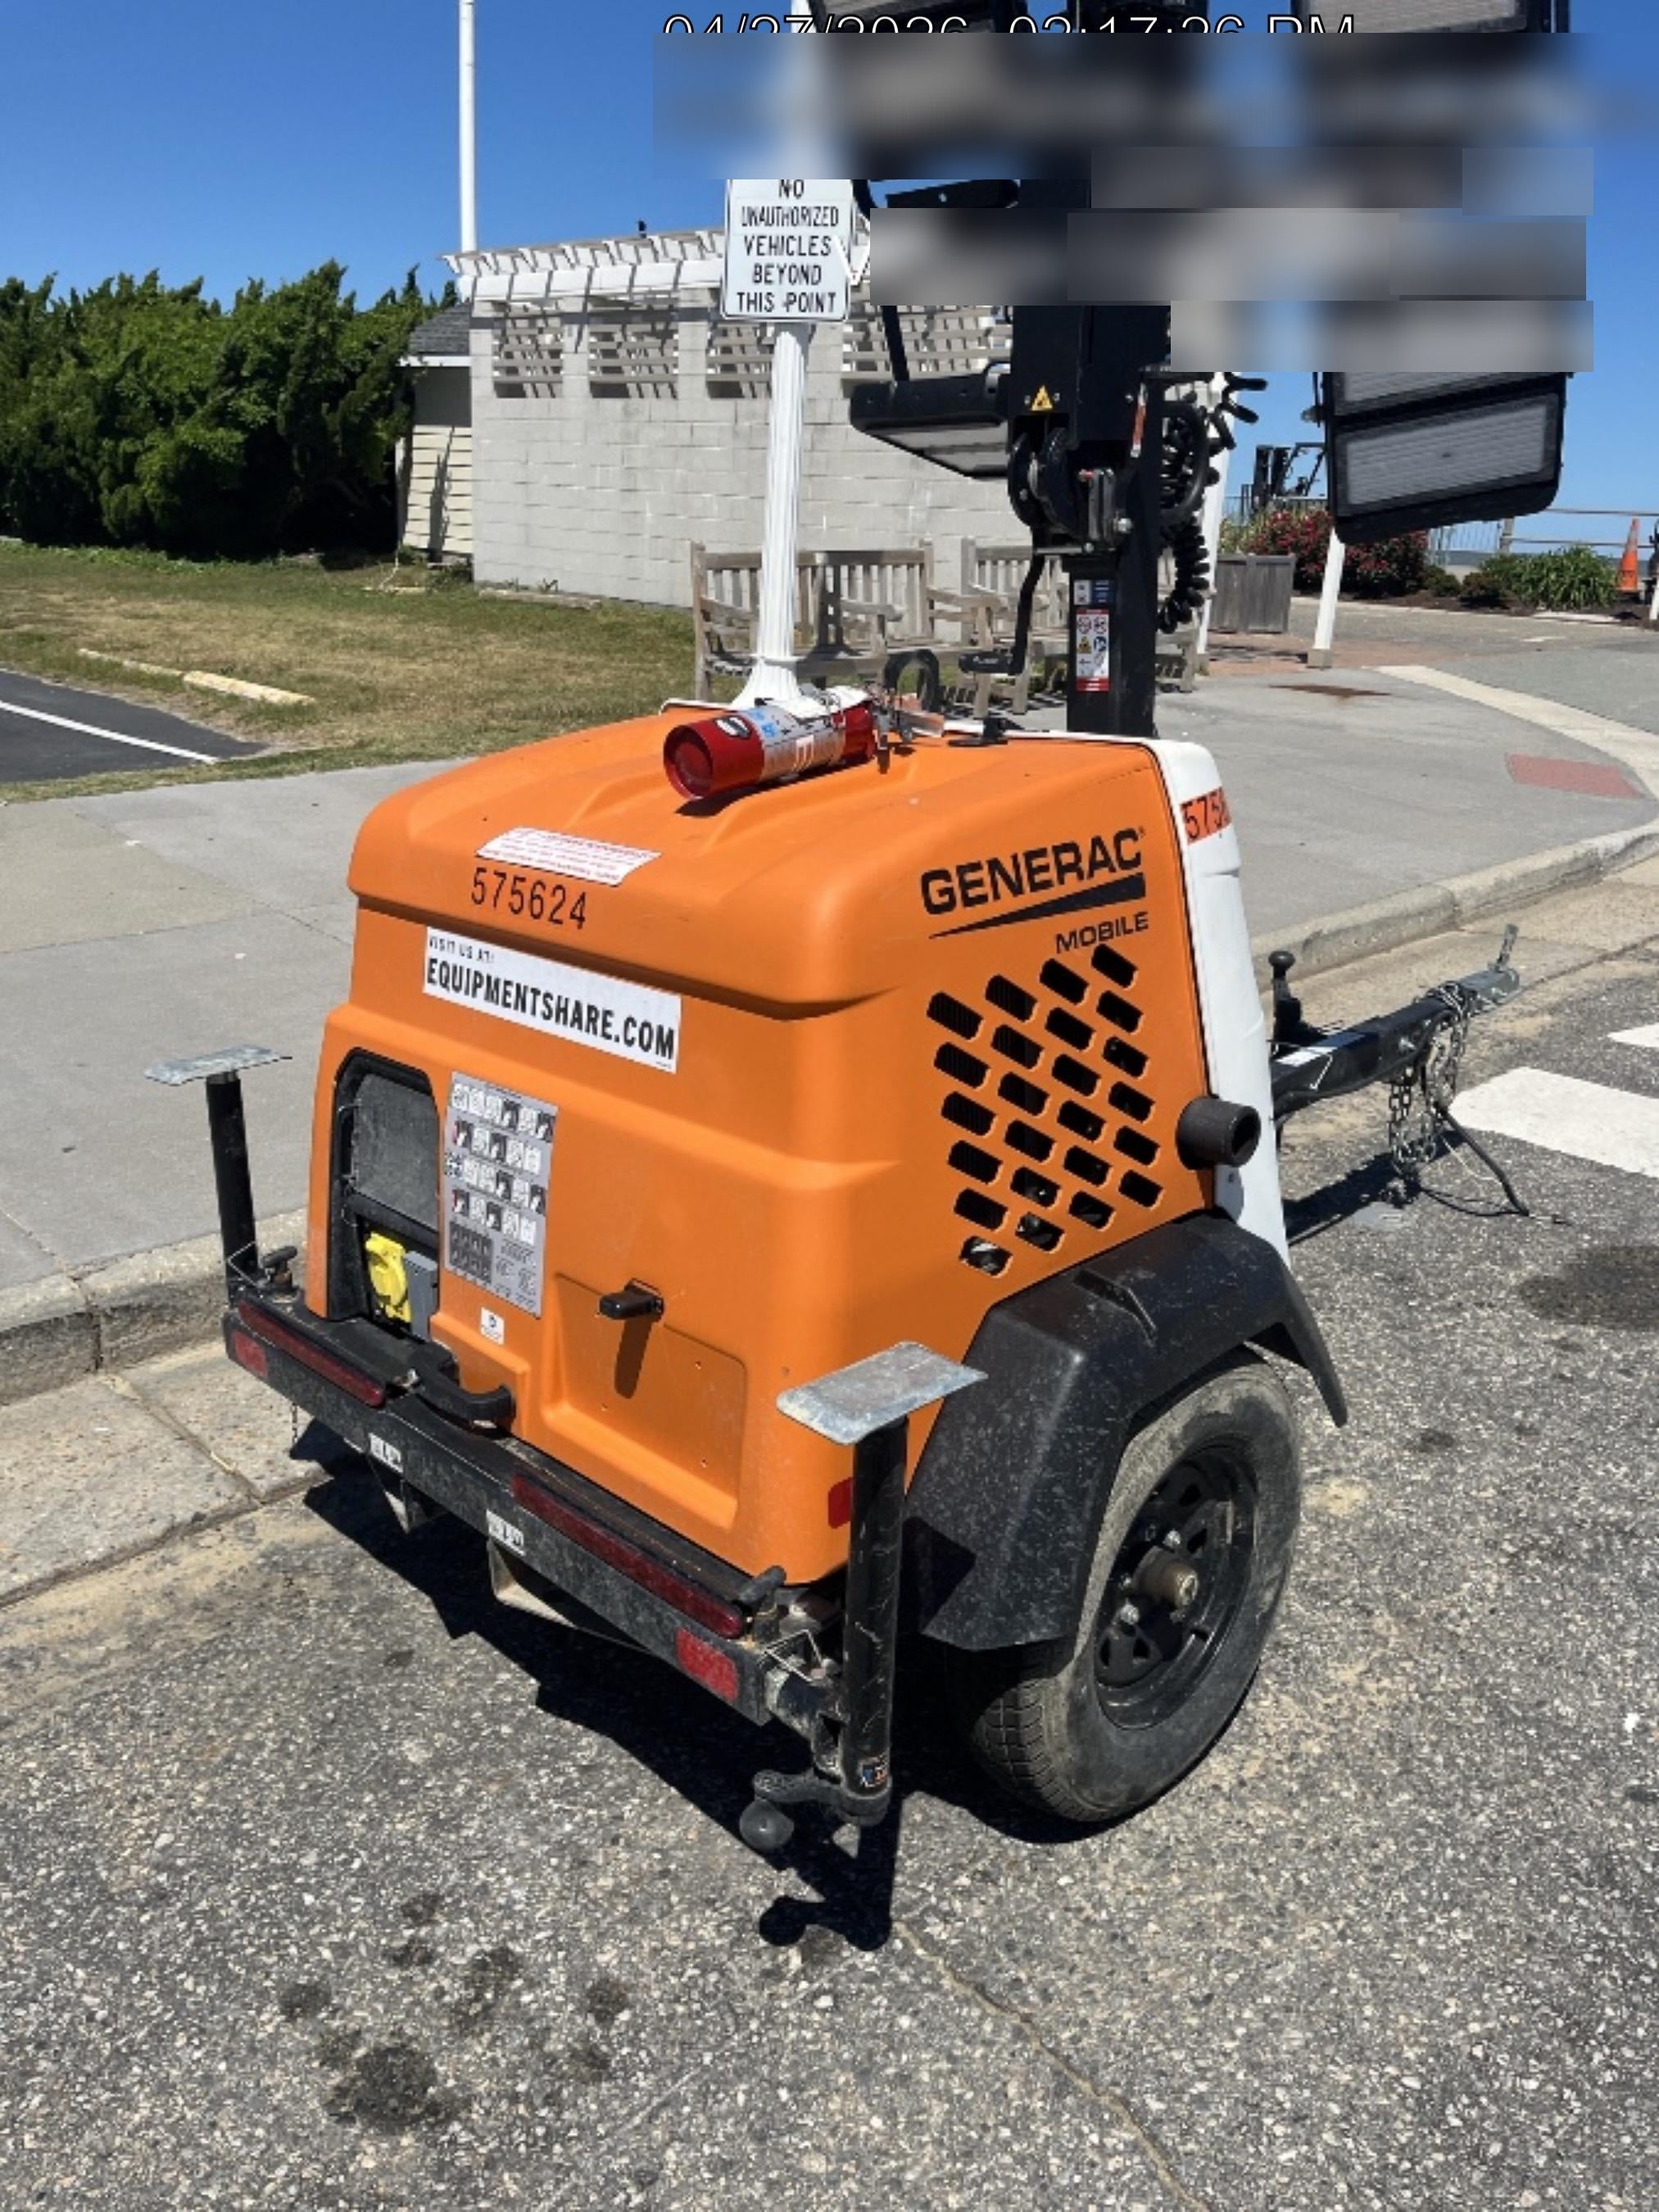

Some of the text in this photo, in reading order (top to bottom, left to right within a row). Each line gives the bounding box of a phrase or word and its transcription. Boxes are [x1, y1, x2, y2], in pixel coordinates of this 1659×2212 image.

[778, 179, 805, 199] NO
[741, 206, 840, 228] UNAUTHORIZED
[743, 235, 832, 257] VEHICLES
[753, 263, 823, 285] BEYOND
[737, 292, 836, 314] THIS POINT
[920, 827, 1142, 915] GENERAC
[471, 866, 587, 930] 575624
[1055, 911, 1149, 954] MOBILE
[429, 936, 456, 954] VISIT
[459, 942, 473, 959] US
[427, 958, 675, 1060] EQUIPMENTSHARE.COM
